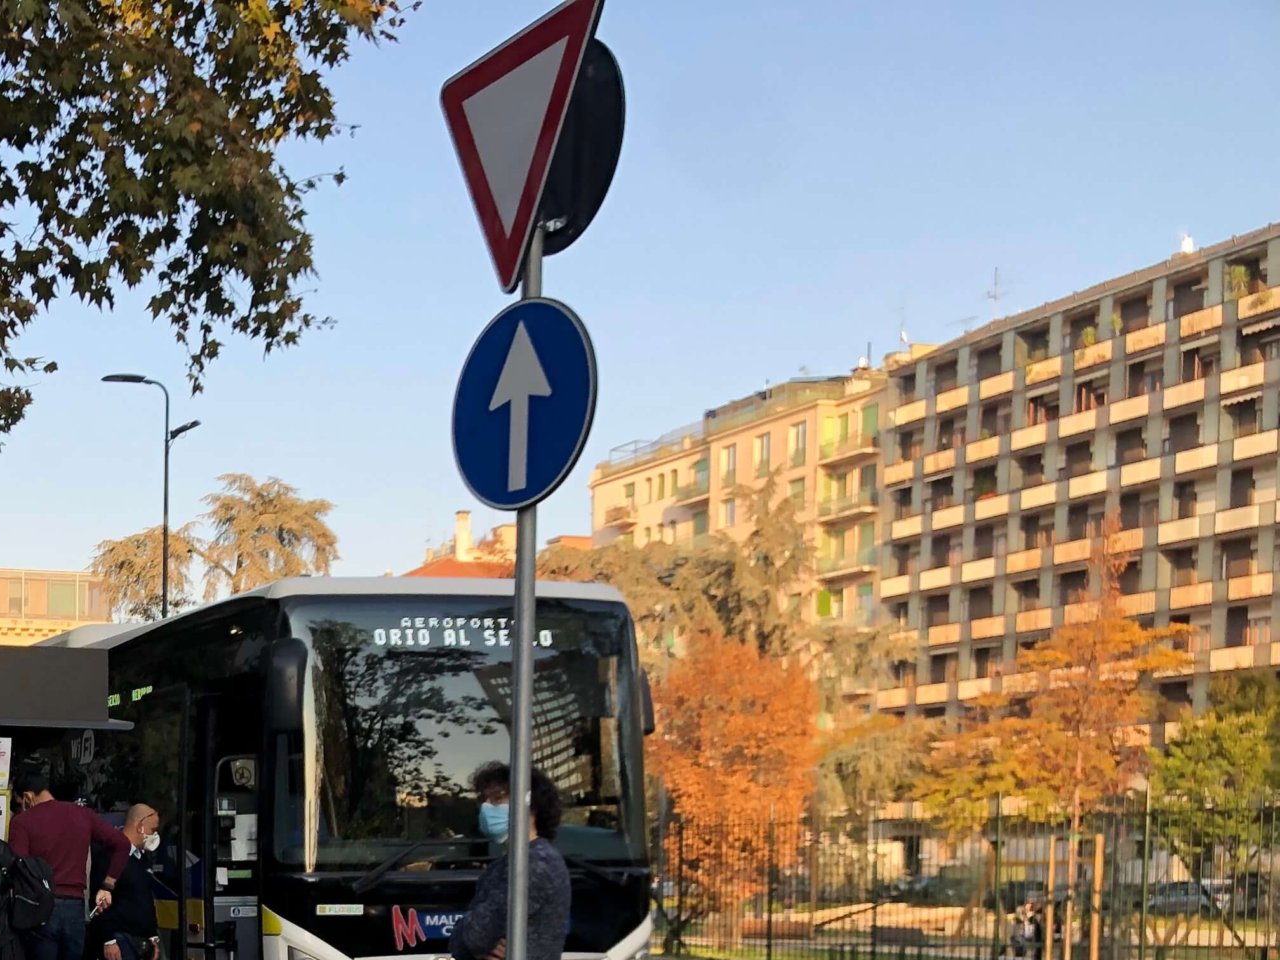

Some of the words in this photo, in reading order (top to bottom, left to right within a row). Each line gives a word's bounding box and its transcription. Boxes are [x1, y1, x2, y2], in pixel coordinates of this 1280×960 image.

[400, 616, 516, 629] AEROPORT
[373, 628, 430, 646] ORIO
[443, 629, 471, 647] AL
[483, 629, 554, 647] SEO
